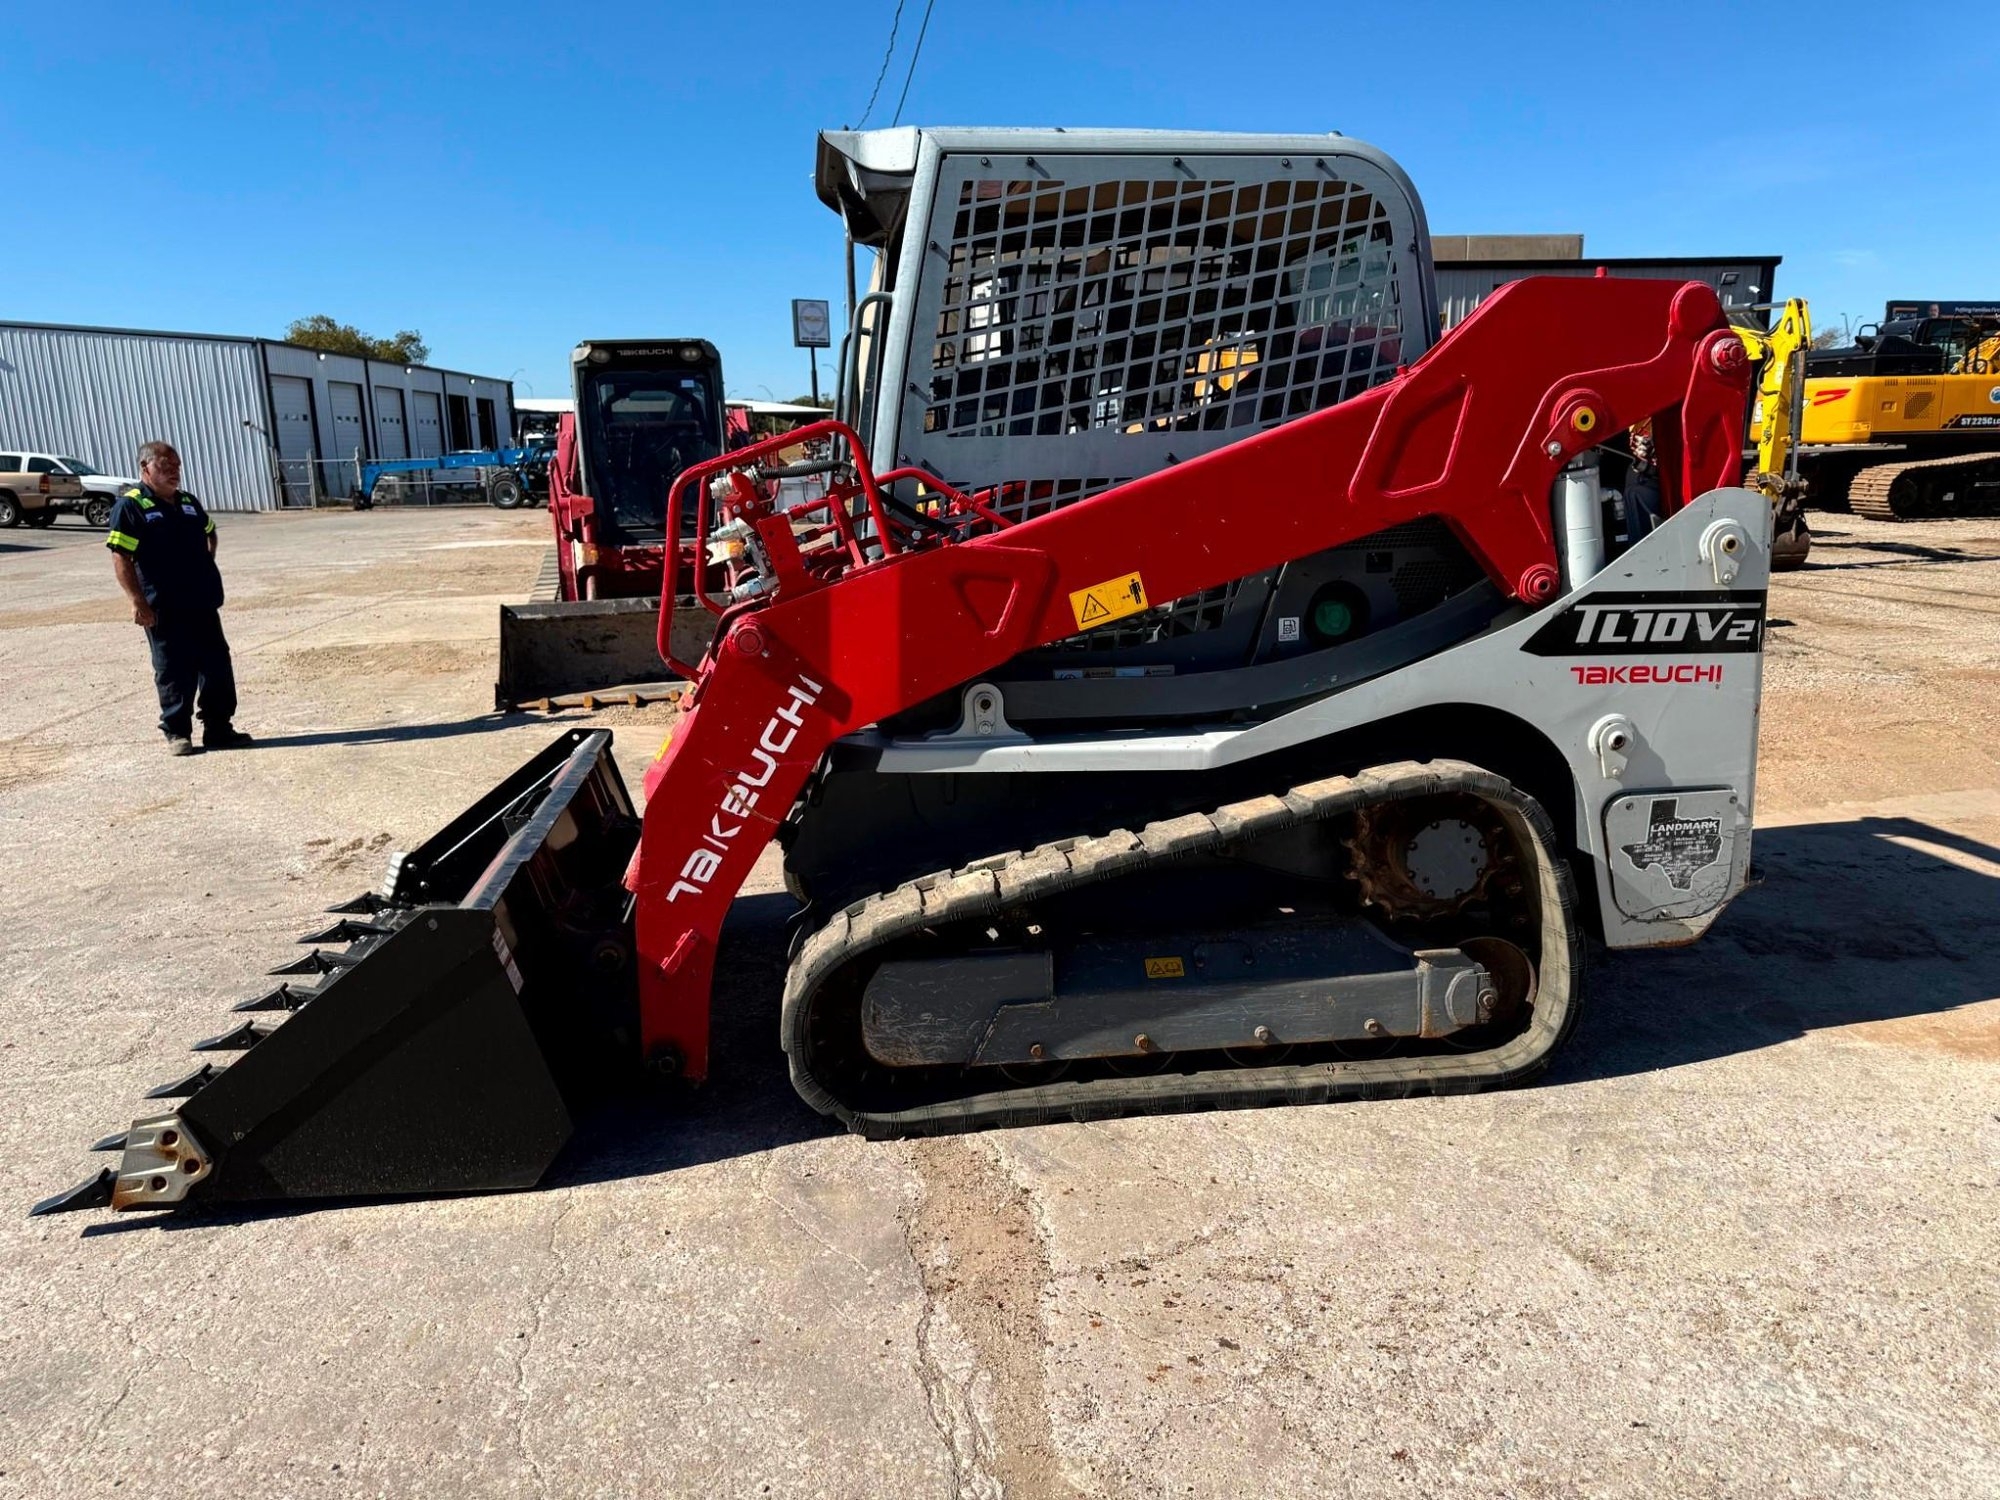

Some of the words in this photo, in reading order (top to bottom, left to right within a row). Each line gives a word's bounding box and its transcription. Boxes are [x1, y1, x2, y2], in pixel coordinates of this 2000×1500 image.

[1574, 602, 1762, 644] TL10V2
[1570, 665, 1723, 685] TAKEUCHI
[666, 674, 823, 903] TAKEUCHI
[1650, 820, 1718, 833] LANDMARK
